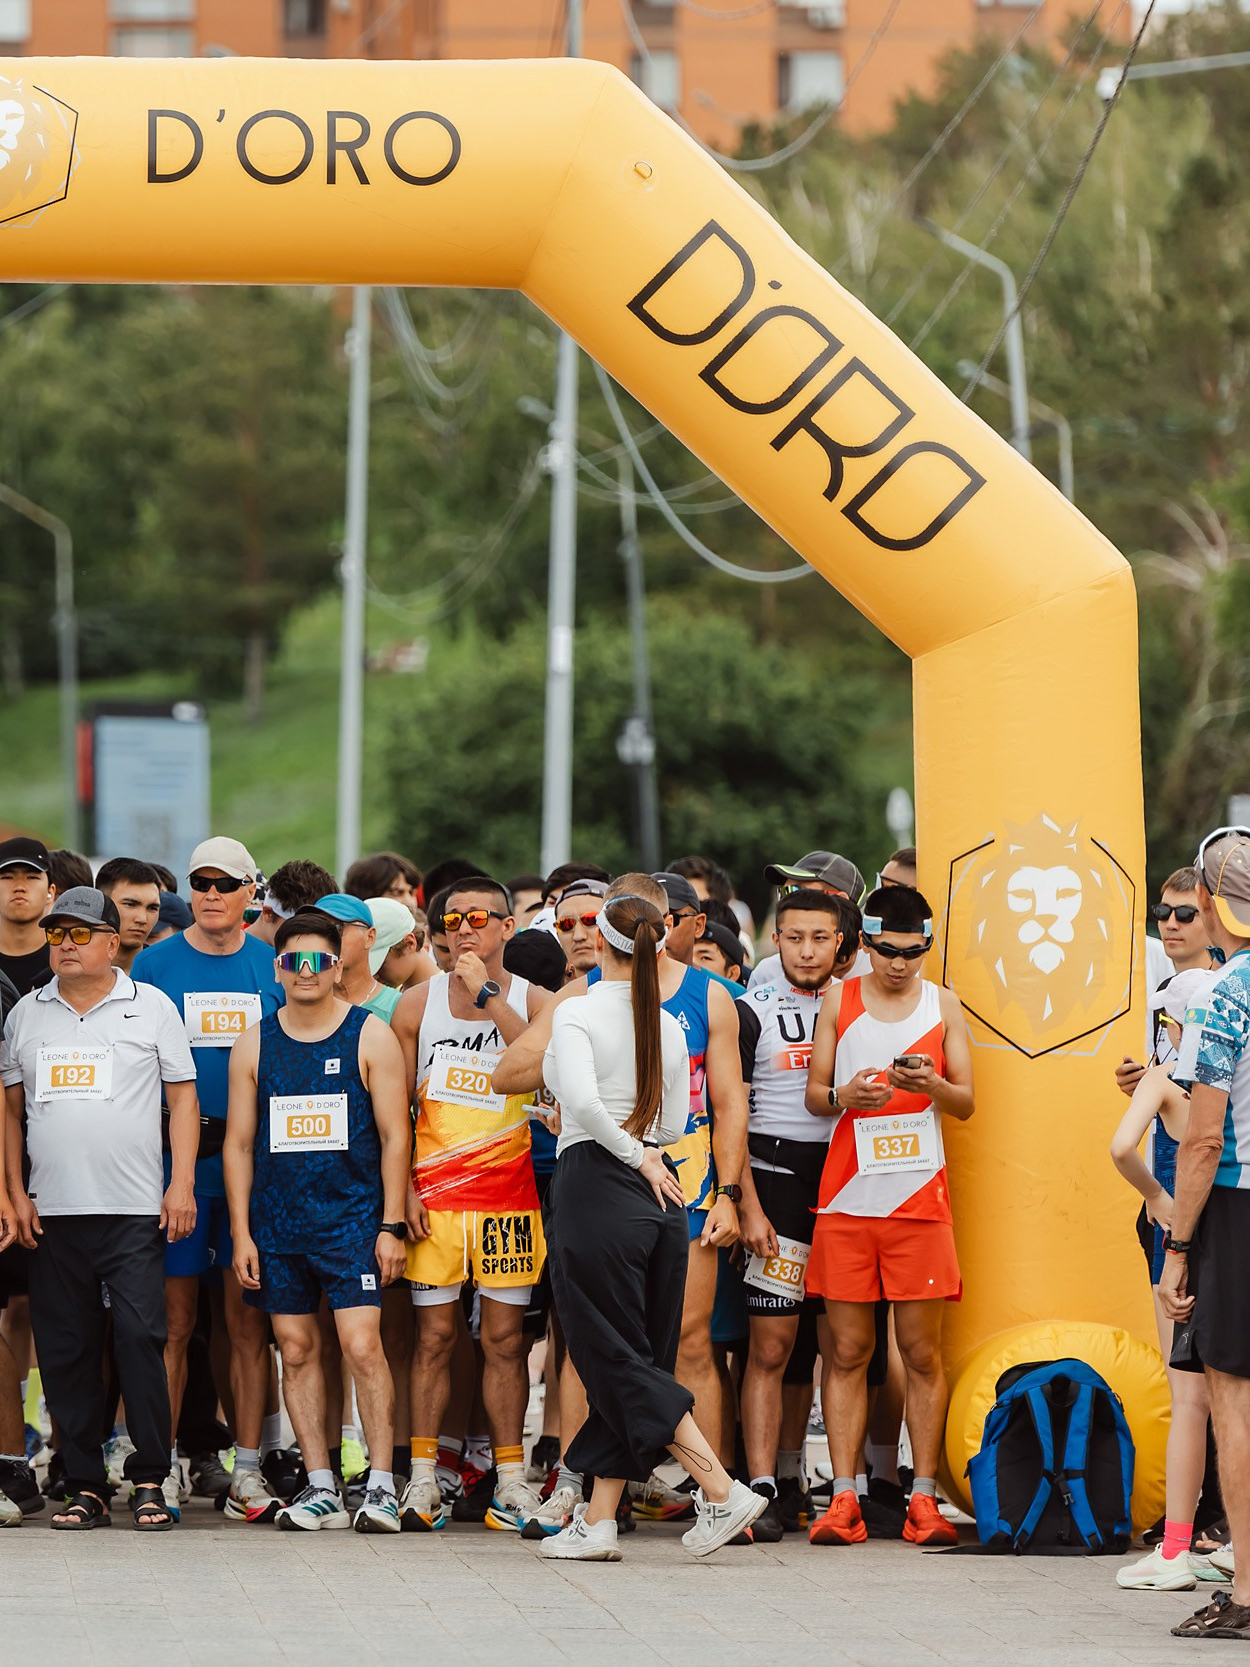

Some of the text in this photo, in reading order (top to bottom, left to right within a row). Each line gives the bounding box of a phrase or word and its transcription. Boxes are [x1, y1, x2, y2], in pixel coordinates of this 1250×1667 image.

[147, 108, 462, 187] D'ORO
[603, 925, 634, 952] CHRISTIA
[191, 999, 218, 1007] LEONE
[206, 1013, 242, 1031] 194
[42, 1053, 69, 1061] LEONE
[440, 1053, 468, 1064] LEONE
[55, 1066, 91, 1085] 192
[450, 1070, 487, 1093] 320
[277, 1102, 303, 1111] LEONE
[291, 1116, 327, 1136] 500
[861, 1123, 890, 1133] LEONE
[878, 1136, 915, 1157] 337
[481, 1215, 533, 1256] GYM
[481, 1256, 533, 1275] SPORTS
[767, 1258, 802, 1283] 338
